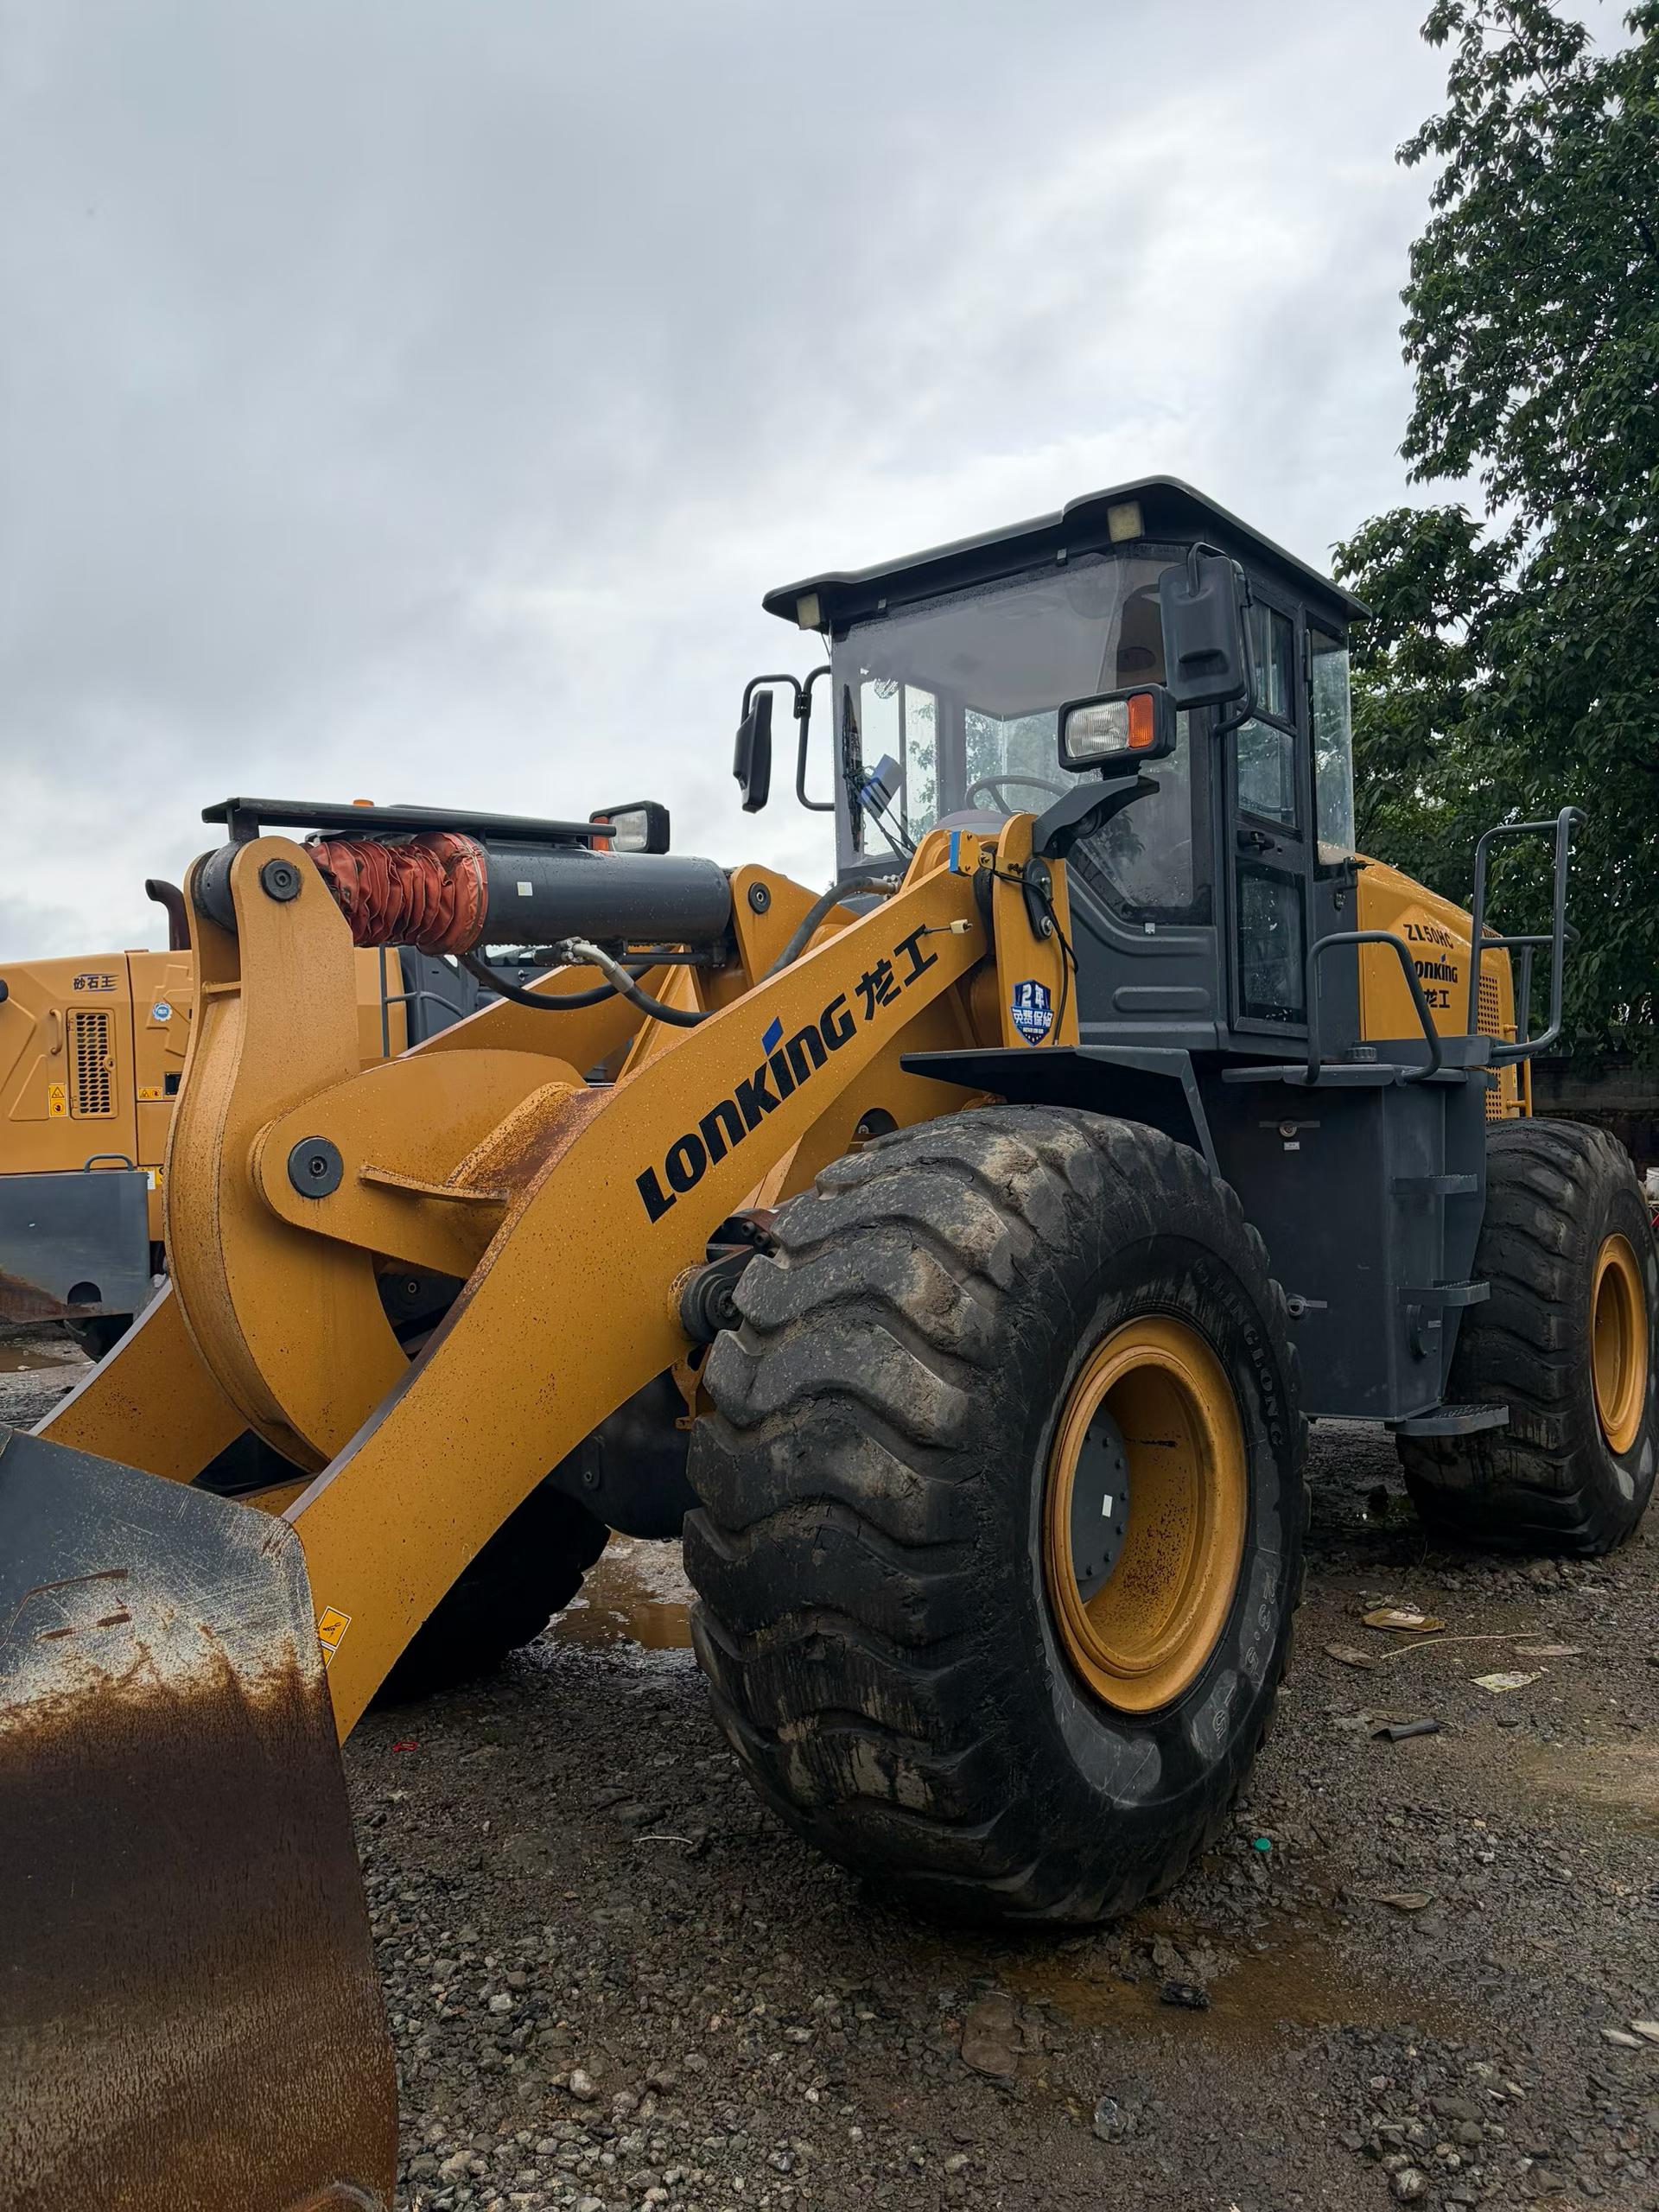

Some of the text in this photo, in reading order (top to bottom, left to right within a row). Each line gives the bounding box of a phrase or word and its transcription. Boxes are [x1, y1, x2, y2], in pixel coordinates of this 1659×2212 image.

[1403, 924, 1454, 949] ZL50HC
[855, 924, 938, 1020] 龙工
[1414, 954, 1458, 983] ONKING
[73, 976, 118, 991] 砂石王
[1423, 988, 1451, 1008] 龙工
